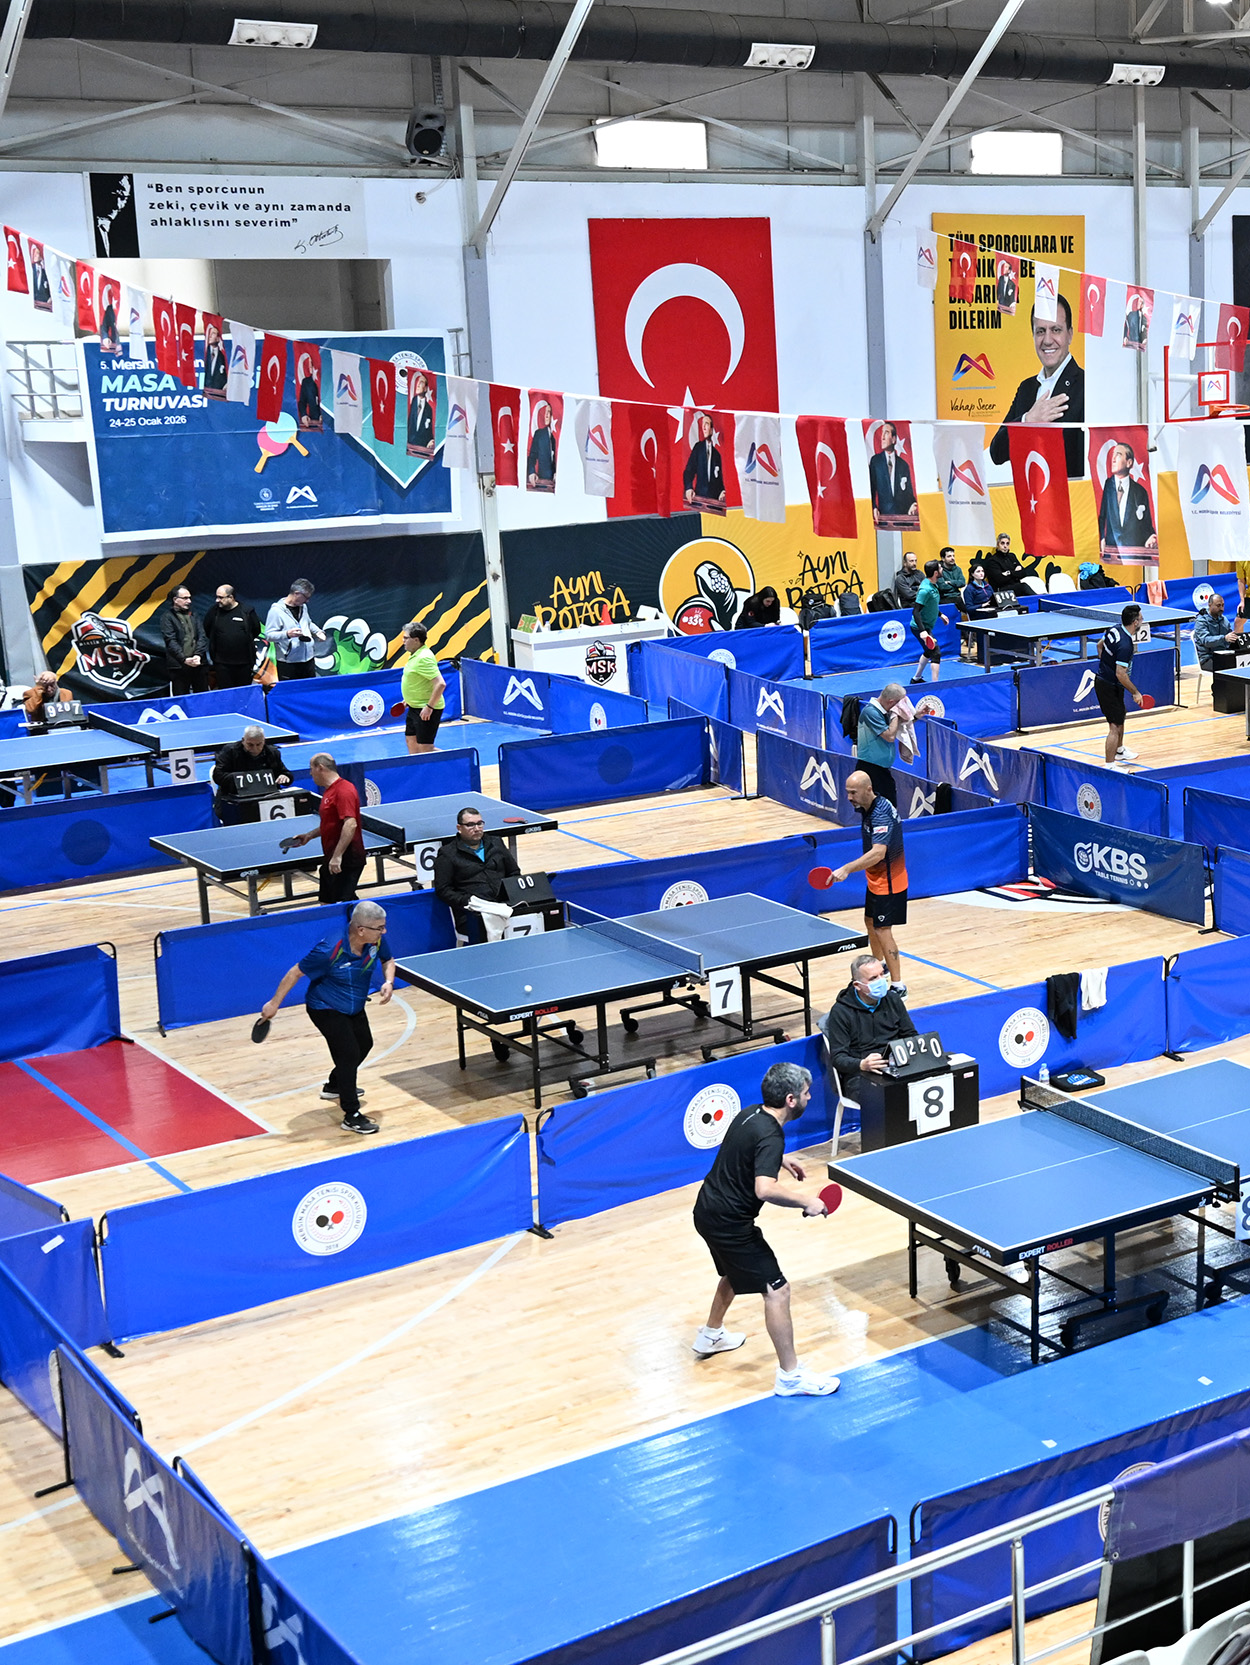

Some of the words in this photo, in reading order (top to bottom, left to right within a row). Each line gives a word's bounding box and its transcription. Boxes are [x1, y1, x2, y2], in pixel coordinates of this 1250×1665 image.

[188, 185, 265, 196] sporcunun
[148, 201, 185, 212] zeki,
[190, 201, 229, 213] çevik
[234, 203, 250, 211] ve
[255, 203, 284, 214] aynı
[290, 203, 351, 212] zamanda
[150, 217, 230, 228] ahlaklısını
[979, 234, 1058, 253] SPORCULARA
[1060, 235, 1074, 254] VE
[949, 307, 1002, 330] DİLERİM
[101, 373, 177, 394] MASA
[102, 394, 208, 412] TURNUVASI
[109, 418, 137, 428] 24-25
[138, 416, 163, 426] Ocak
[164, 415, 187, 425] 2026
[1134, 630, 1148, 642] 12
[585, 659, 617, 676] MSK
[175, 758, 191, 780] 5
[419, 846, 435, 872] 6
[1092, 842, 1149, 881] KBS
[1095, 870, 1110, 880] TABLE
[1110, 874, 1129, 886] TENNIS
[838, 943, 857, 952] STIGA
[714, 979, 735, 1010] 7
[510, 1011, 534, 1021] EXPERT
[534, 1006, 559, 1016] ROLLER
[922, 1084, 944, 1118] 8
[971, 1243, 991, 1259] STIGA
[1019, 1246, 1045, 1260] EXPERT
[1046, 1237, 1074, 1252] ROLLER
